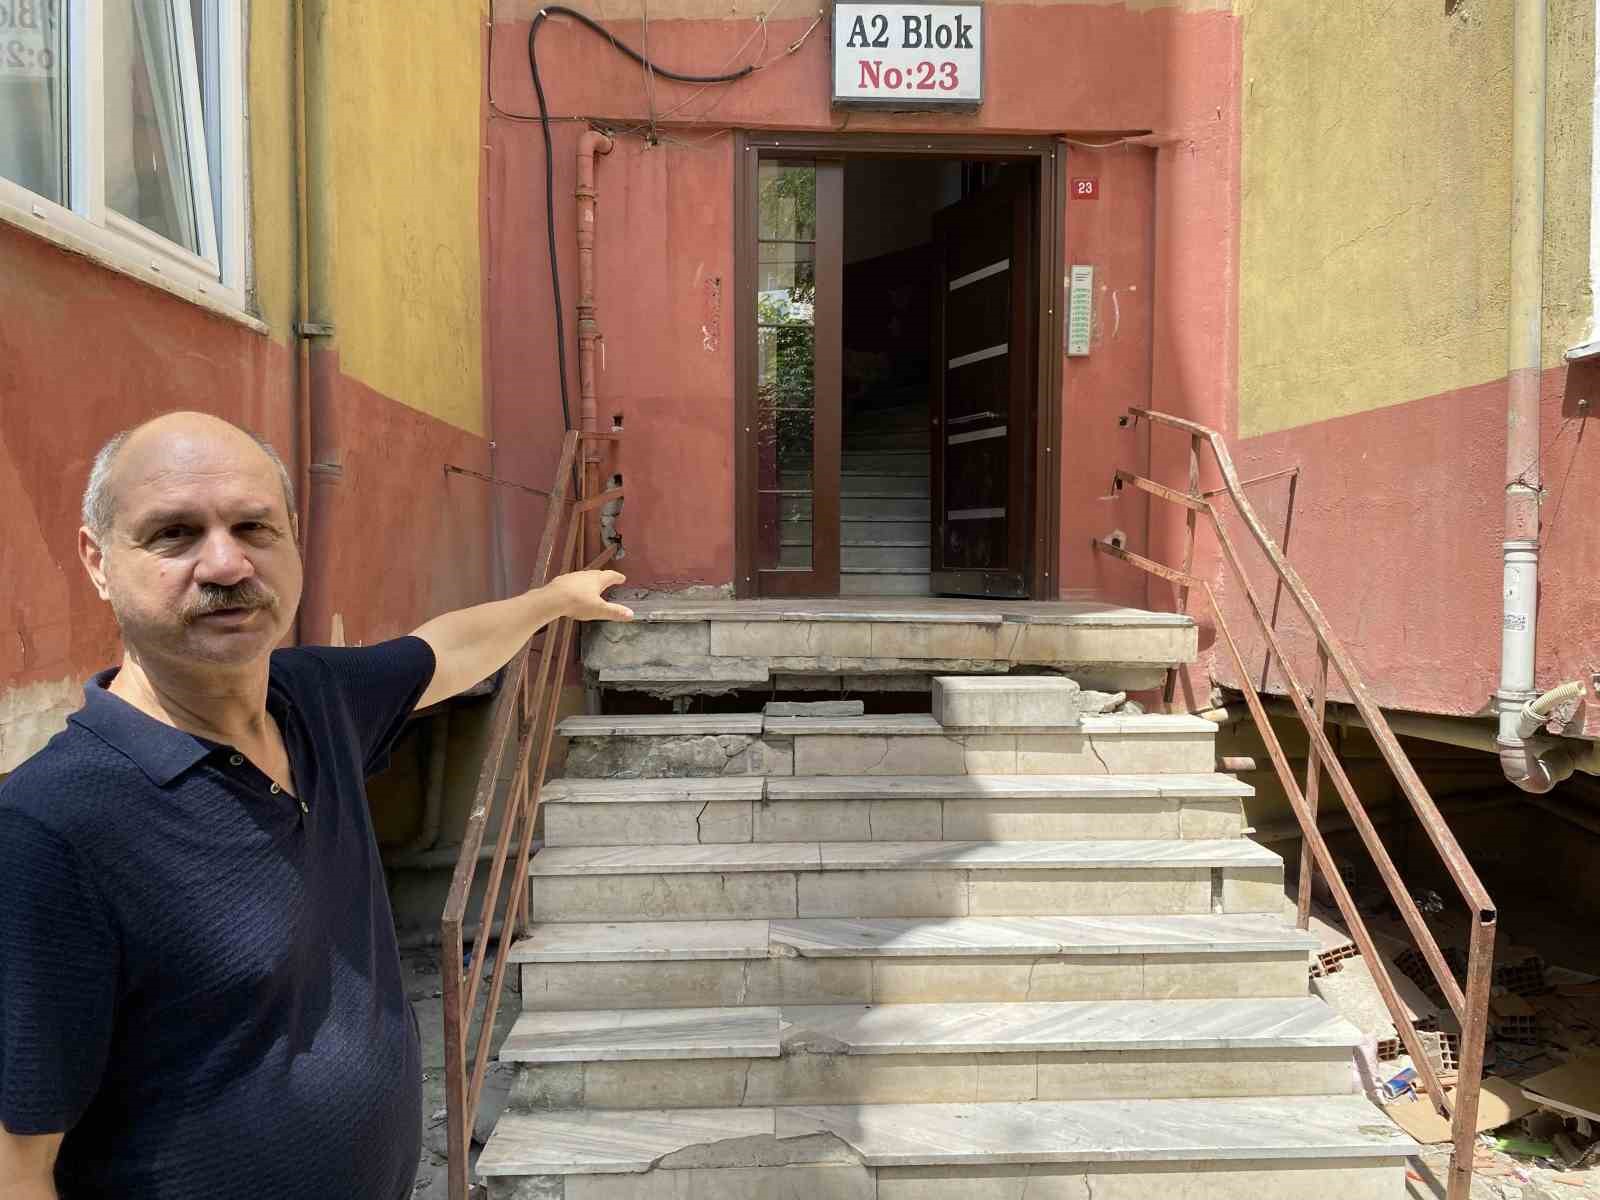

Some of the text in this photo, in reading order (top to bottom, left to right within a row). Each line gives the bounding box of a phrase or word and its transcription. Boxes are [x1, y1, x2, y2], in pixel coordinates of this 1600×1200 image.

[847, 13, 974, 49] A2 Blok
[858, 60, 959, 91] No:23
[1078, 181, 1093, 194] 23
